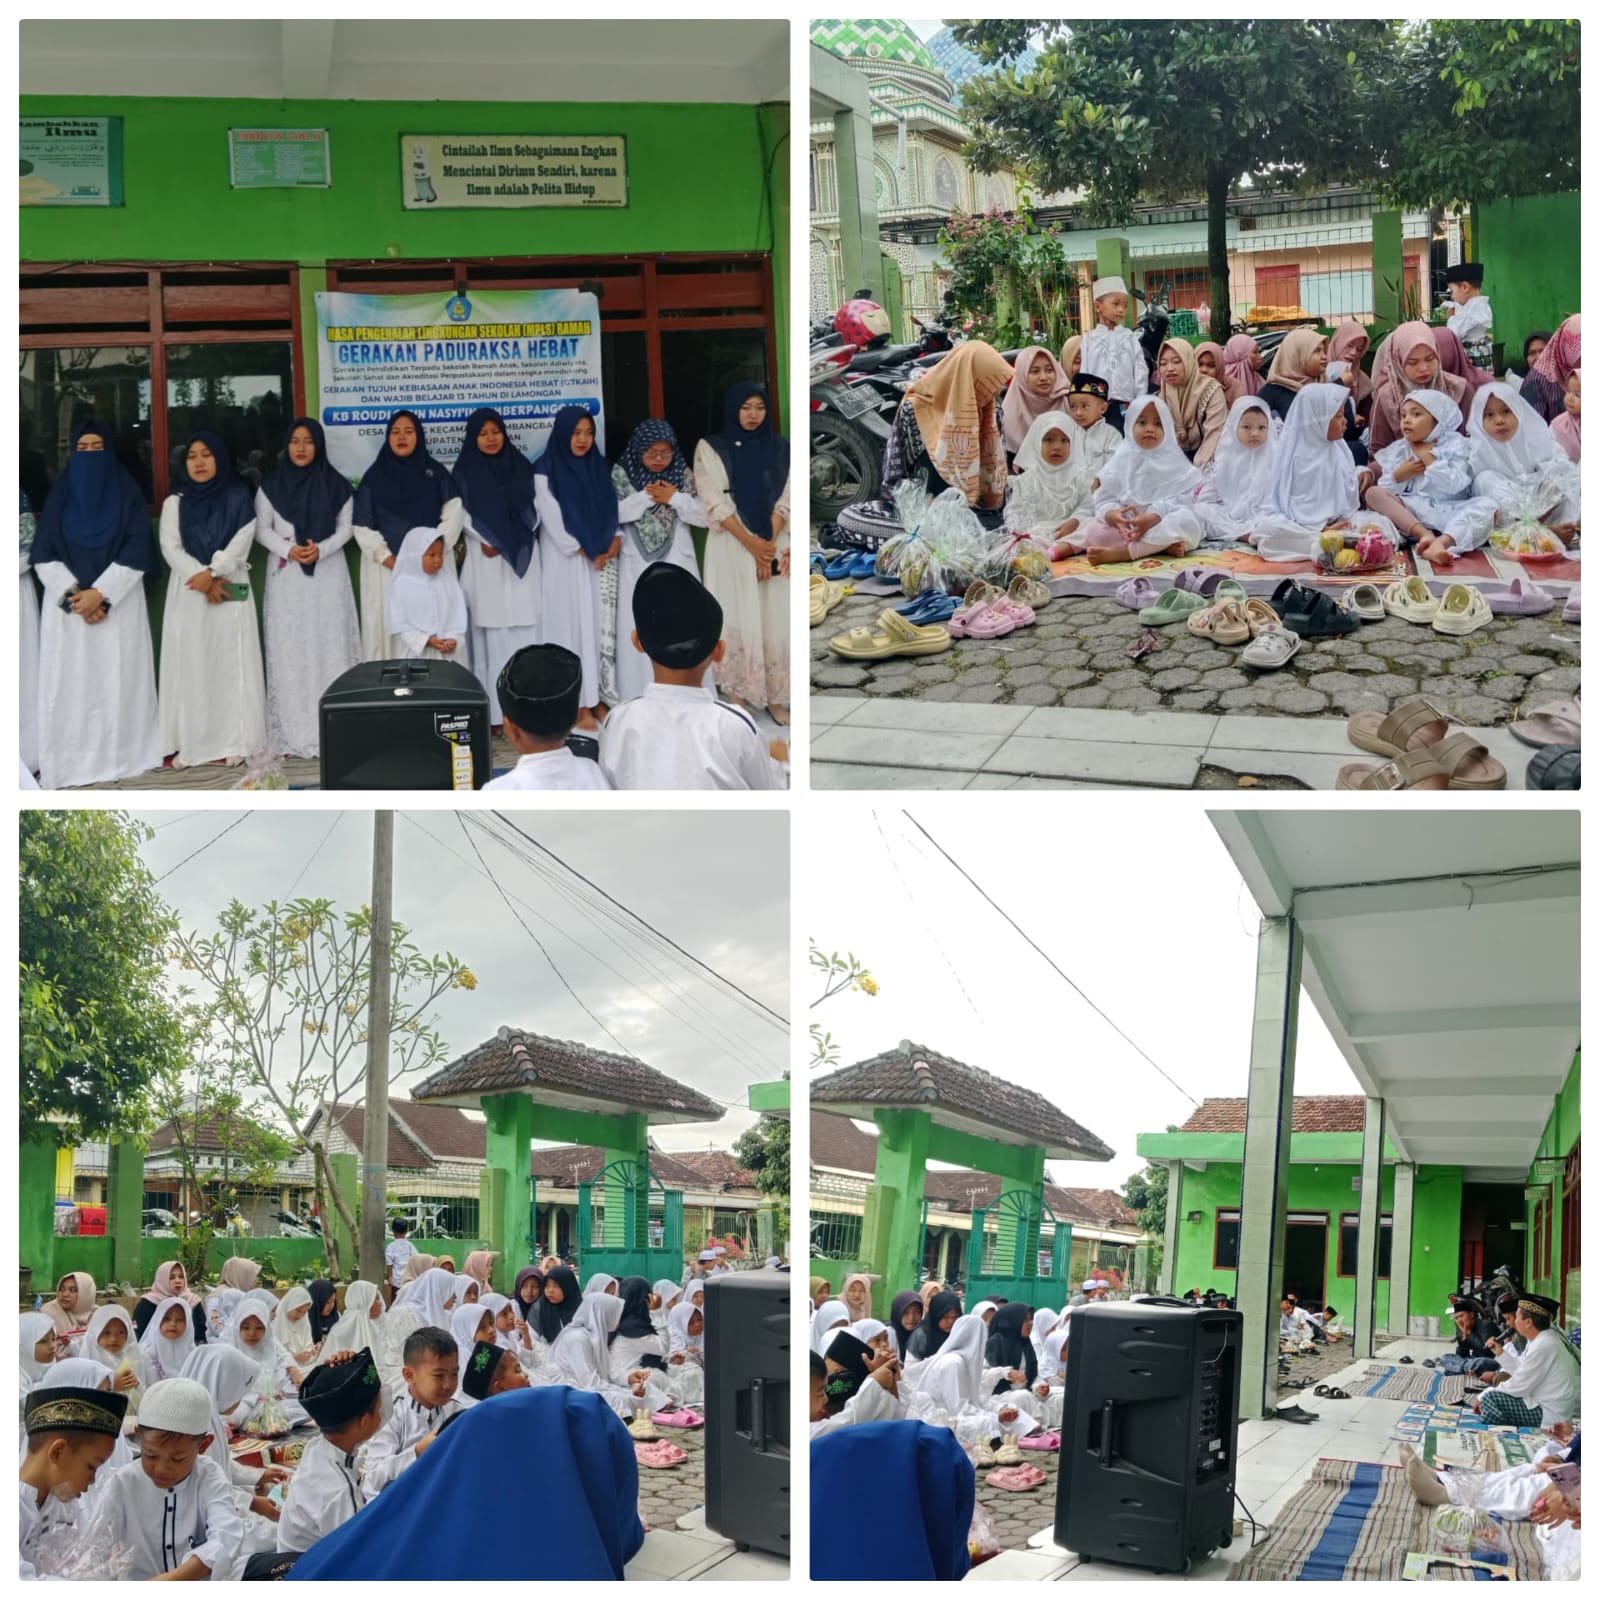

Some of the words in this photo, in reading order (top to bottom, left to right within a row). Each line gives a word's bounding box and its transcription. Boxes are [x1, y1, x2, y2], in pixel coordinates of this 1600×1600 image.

[45, 127, 98, 137] Ilmu
[442, 144, 489, 157] Cintailah
[490, 144, 513, 157] Ilmu
[514, 144, 580, 160] Sebagaimana
[442, 164, 497, 177] Mencintai
[498, 164, 536, 177] Dirimu
[580, 164, 617, 177] karena
[467, 183, 492, 195] Ilmu
[494, 183, 530, 195] adalah
[531, 183, 562, 195] Pelita
[563, 183, 595, 198] Hidup
[417, 324, 478, 340] LINGKUNGAN
[479, 322, 521, 339] SEKOLAH
[522, 321, 555, 337] (MPLS)
[556, 320, 592, 336] RAMAH
[338, 342, 417, 364] GERAKAN
[424, 340, 522, 363] PADURAKSA
[527, 338, 579, 359] HEBAT
[323, 385, 365, 394] GERAKAN
[367, 384, 397, 393] TUJUH
[399, 383, 450, 392] KEBIASAAN
[451, 382, 477, 391] ANAK
[479, 380, 527, 390] INDONESIA
[529, 379, 559, 388] HEBAT
[361, 395, 381, 404] DAN
[382, 395, 413, 403] WAJIB
[415, 393, 455, 402] BELAJAR
[456, 393, 465, 401] 13
[466, 391, 499, 400] TAHUN
[500, 391, 510, 399] DI
[511, 389, 562, 398] LAMONGAN
[332, 411, 349, 422] KB
[358, 428, 384, 437] DESA
